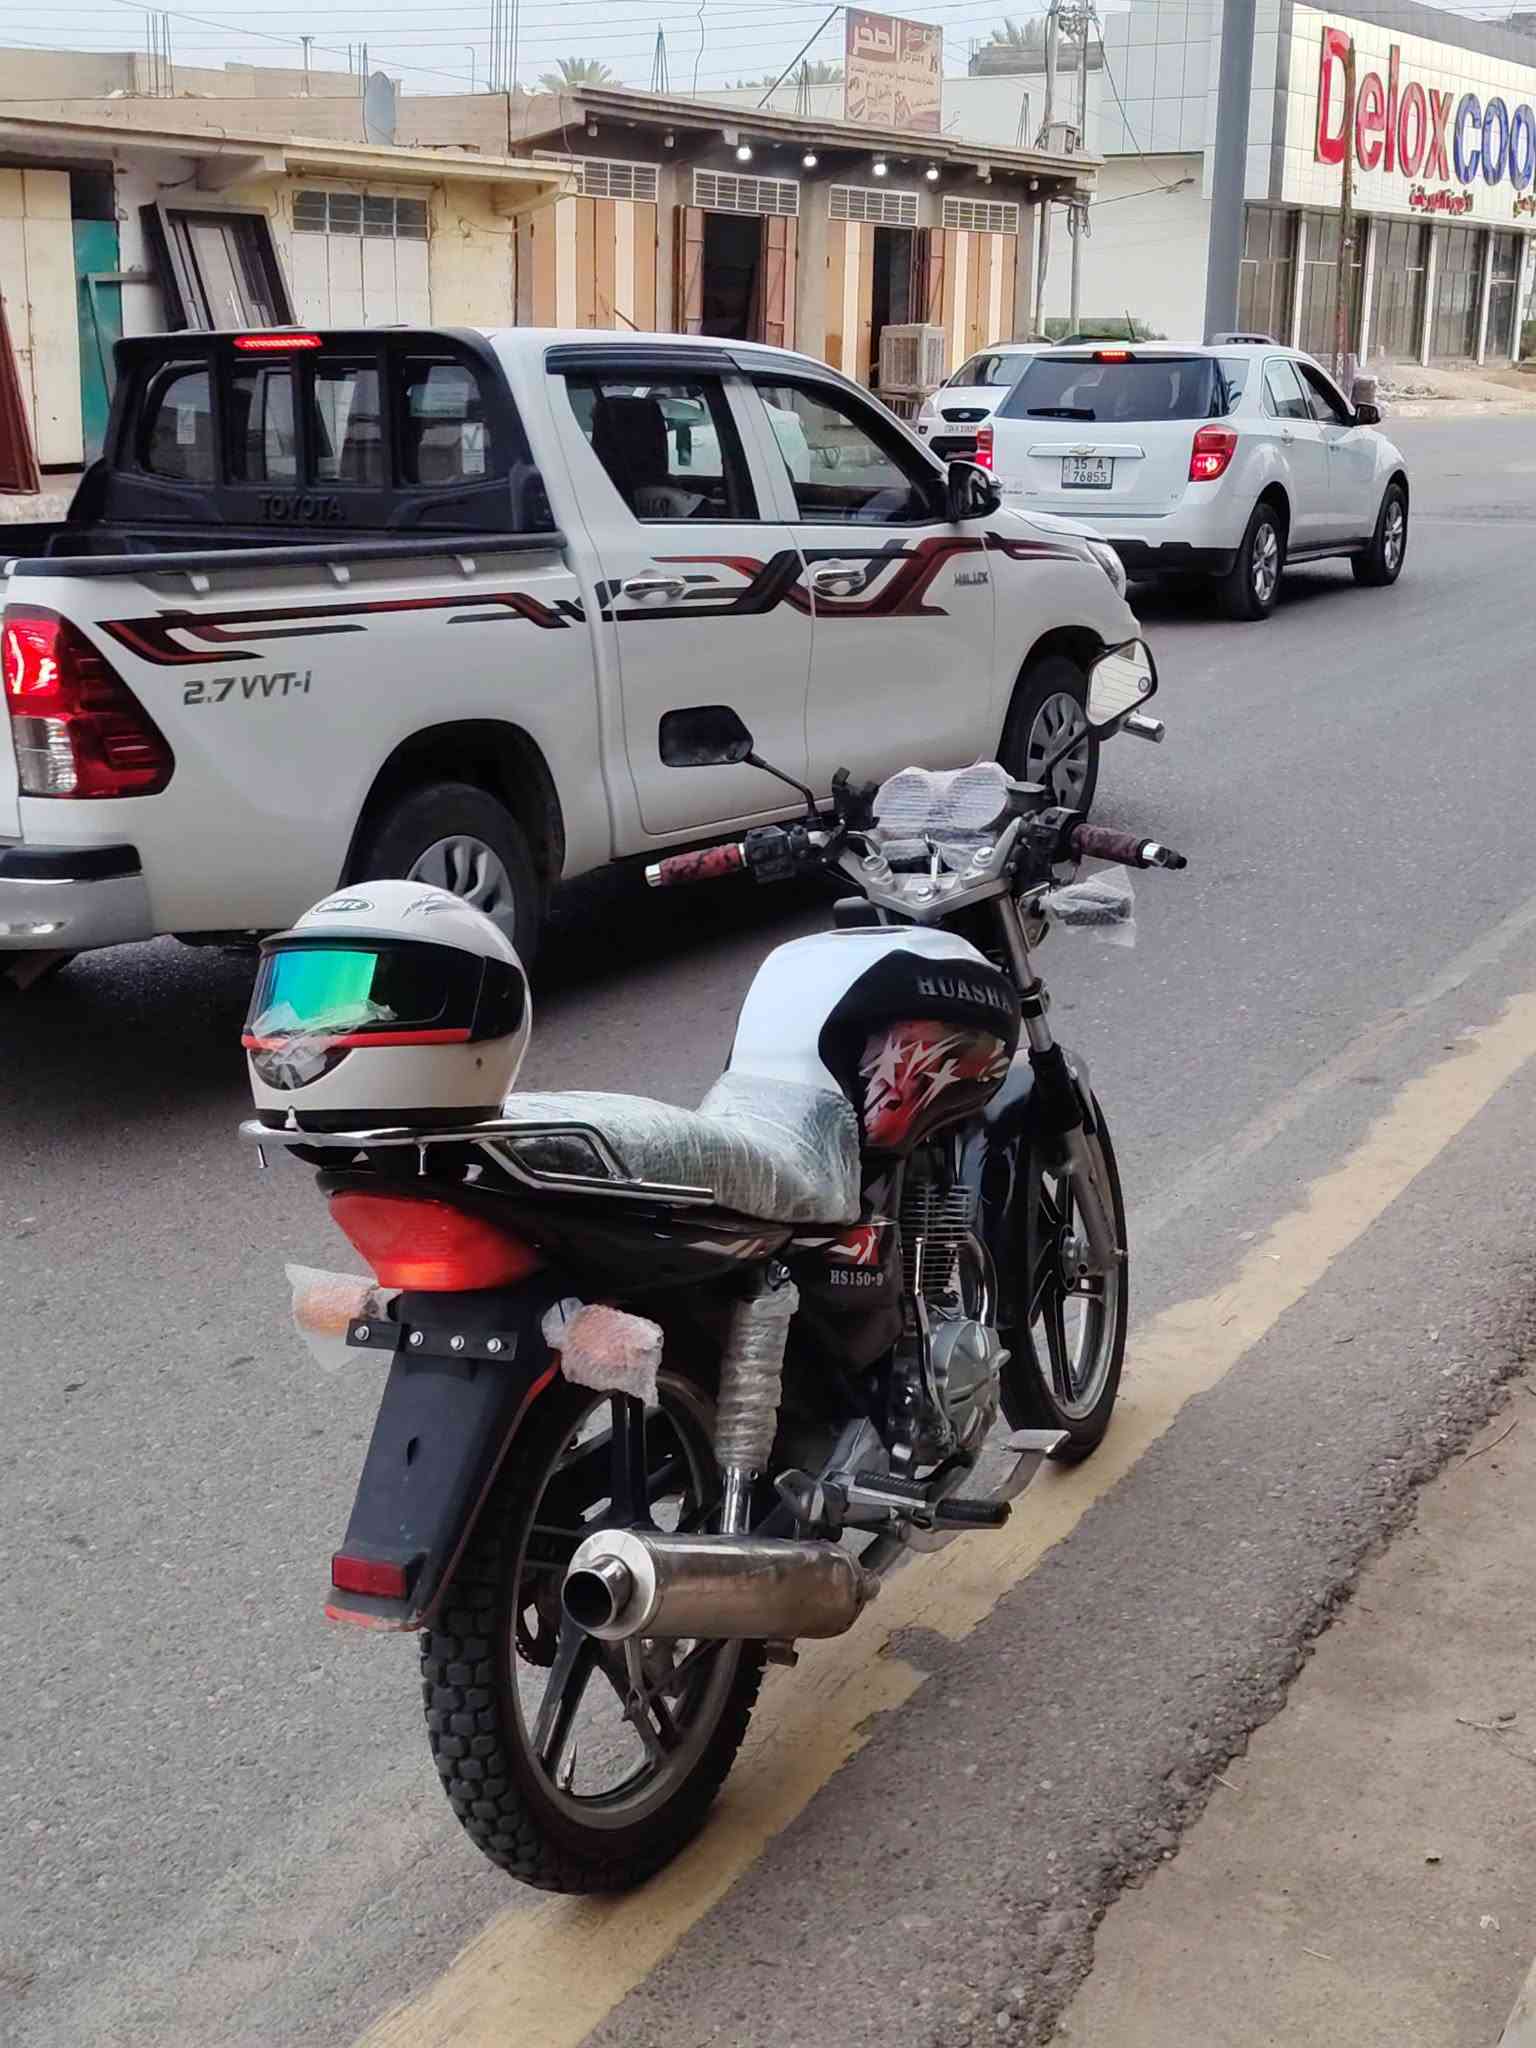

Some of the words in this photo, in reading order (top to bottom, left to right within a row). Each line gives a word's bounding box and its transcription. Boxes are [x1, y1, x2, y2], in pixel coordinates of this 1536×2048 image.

[1314, 25, 1455, 181] Delox
[1454, 92, 1536, 191] coo
[1072, 471, 1107, 482] 76855
[1073, 459, 1088, 470] 15
[1096, 459, 1104, 470] A
[257, 495, 345, 520] TOYOTA
[183, 677, 237, 706] 2.7
